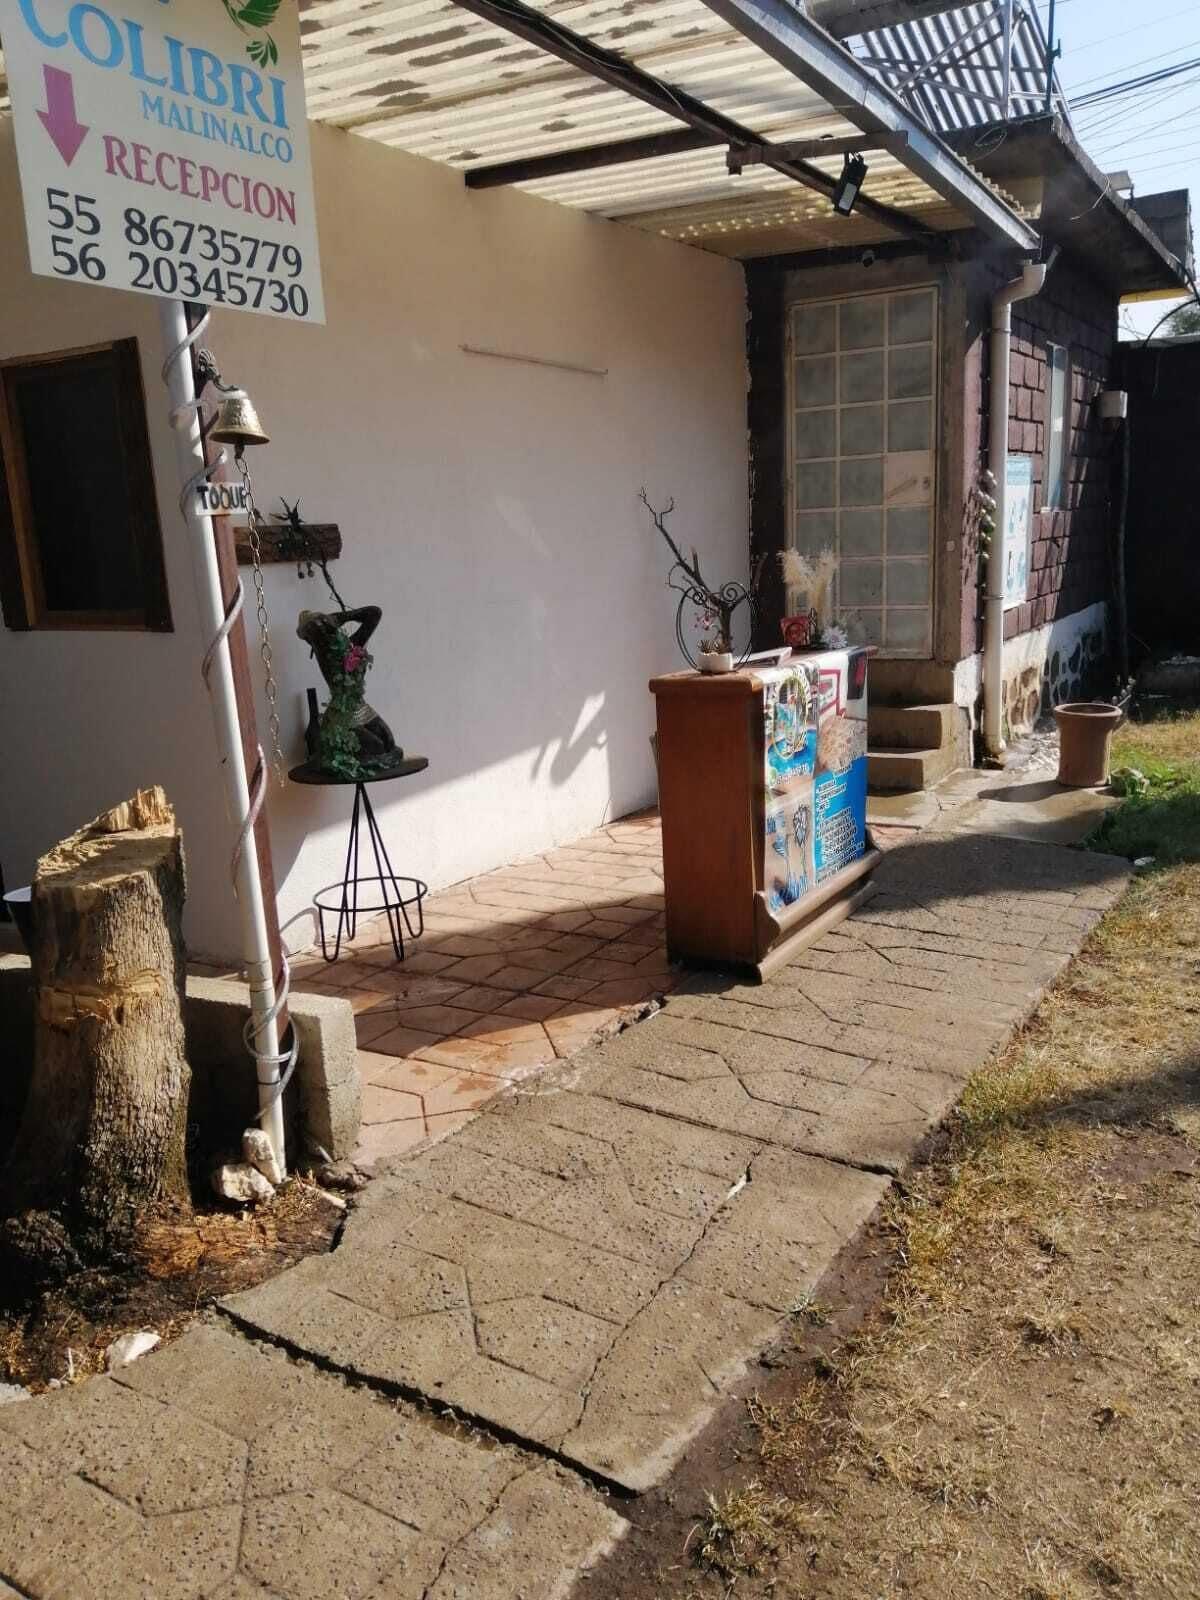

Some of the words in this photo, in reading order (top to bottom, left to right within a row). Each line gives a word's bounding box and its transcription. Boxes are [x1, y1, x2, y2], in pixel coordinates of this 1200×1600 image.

[19, 0, 290, 130] COLIBRI
[140, 91, 293, 163] MALINALCO
[102, 135, 297, 225] RECEPCION
[46, 187, 101, 236] 55
[124, 207, 303, 278] 86735779
[51, 235, 106, 281] 56
[128, 251, 309, 317] 20345730
